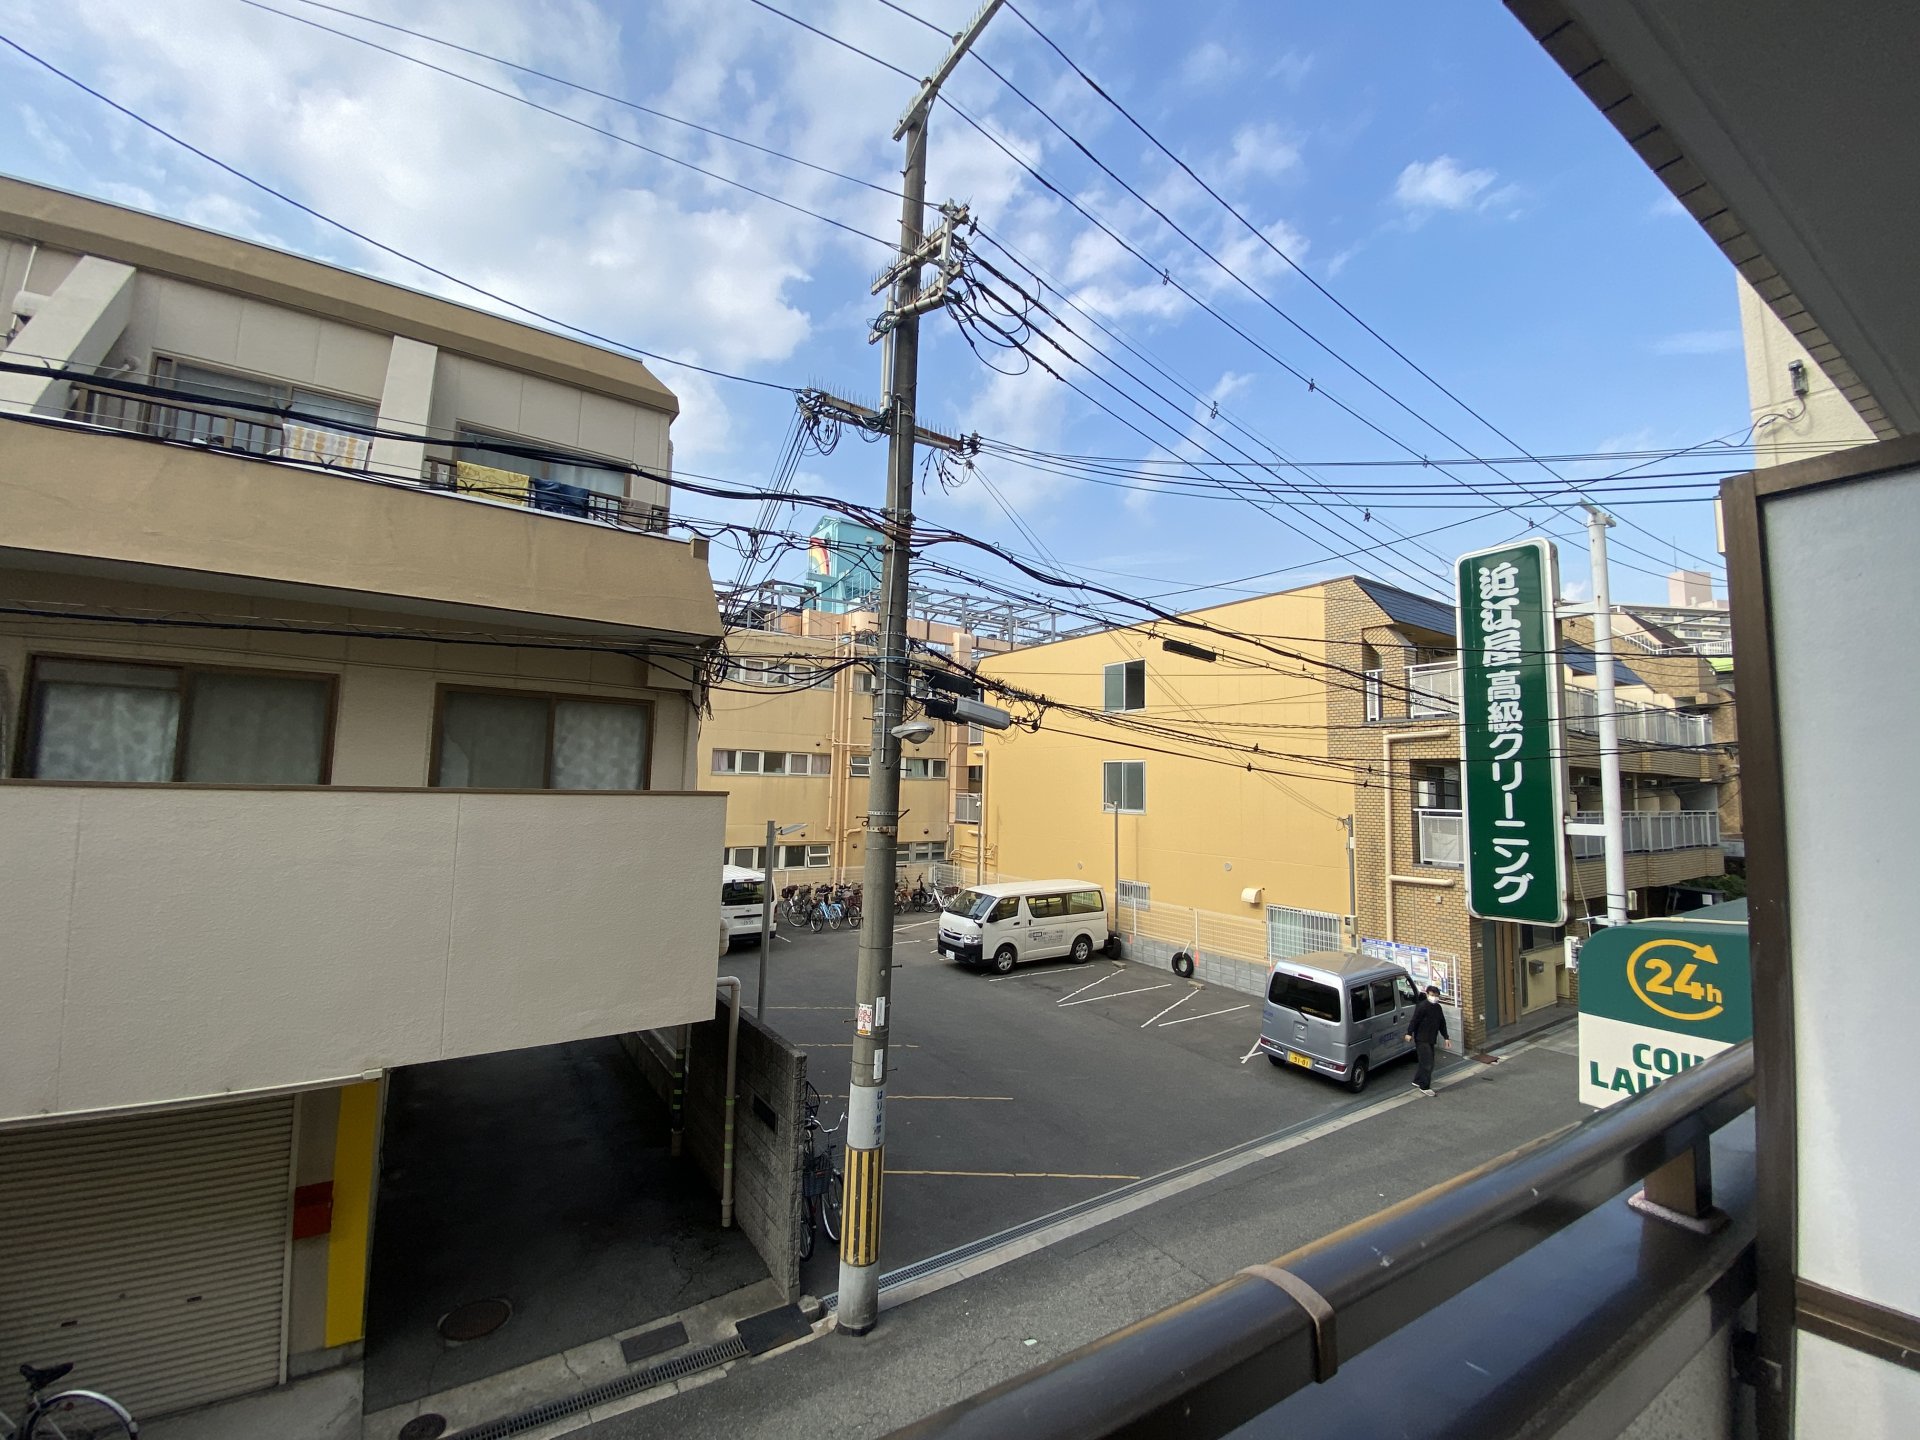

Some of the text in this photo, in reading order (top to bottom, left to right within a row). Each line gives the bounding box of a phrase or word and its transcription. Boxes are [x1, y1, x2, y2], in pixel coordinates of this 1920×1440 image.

[1479, 561, 1534, 904] 近江屋高級クリーニング
[1644, 958, 1723, 1004] 24h
[1632, 1043, 1705, 1075] COI
